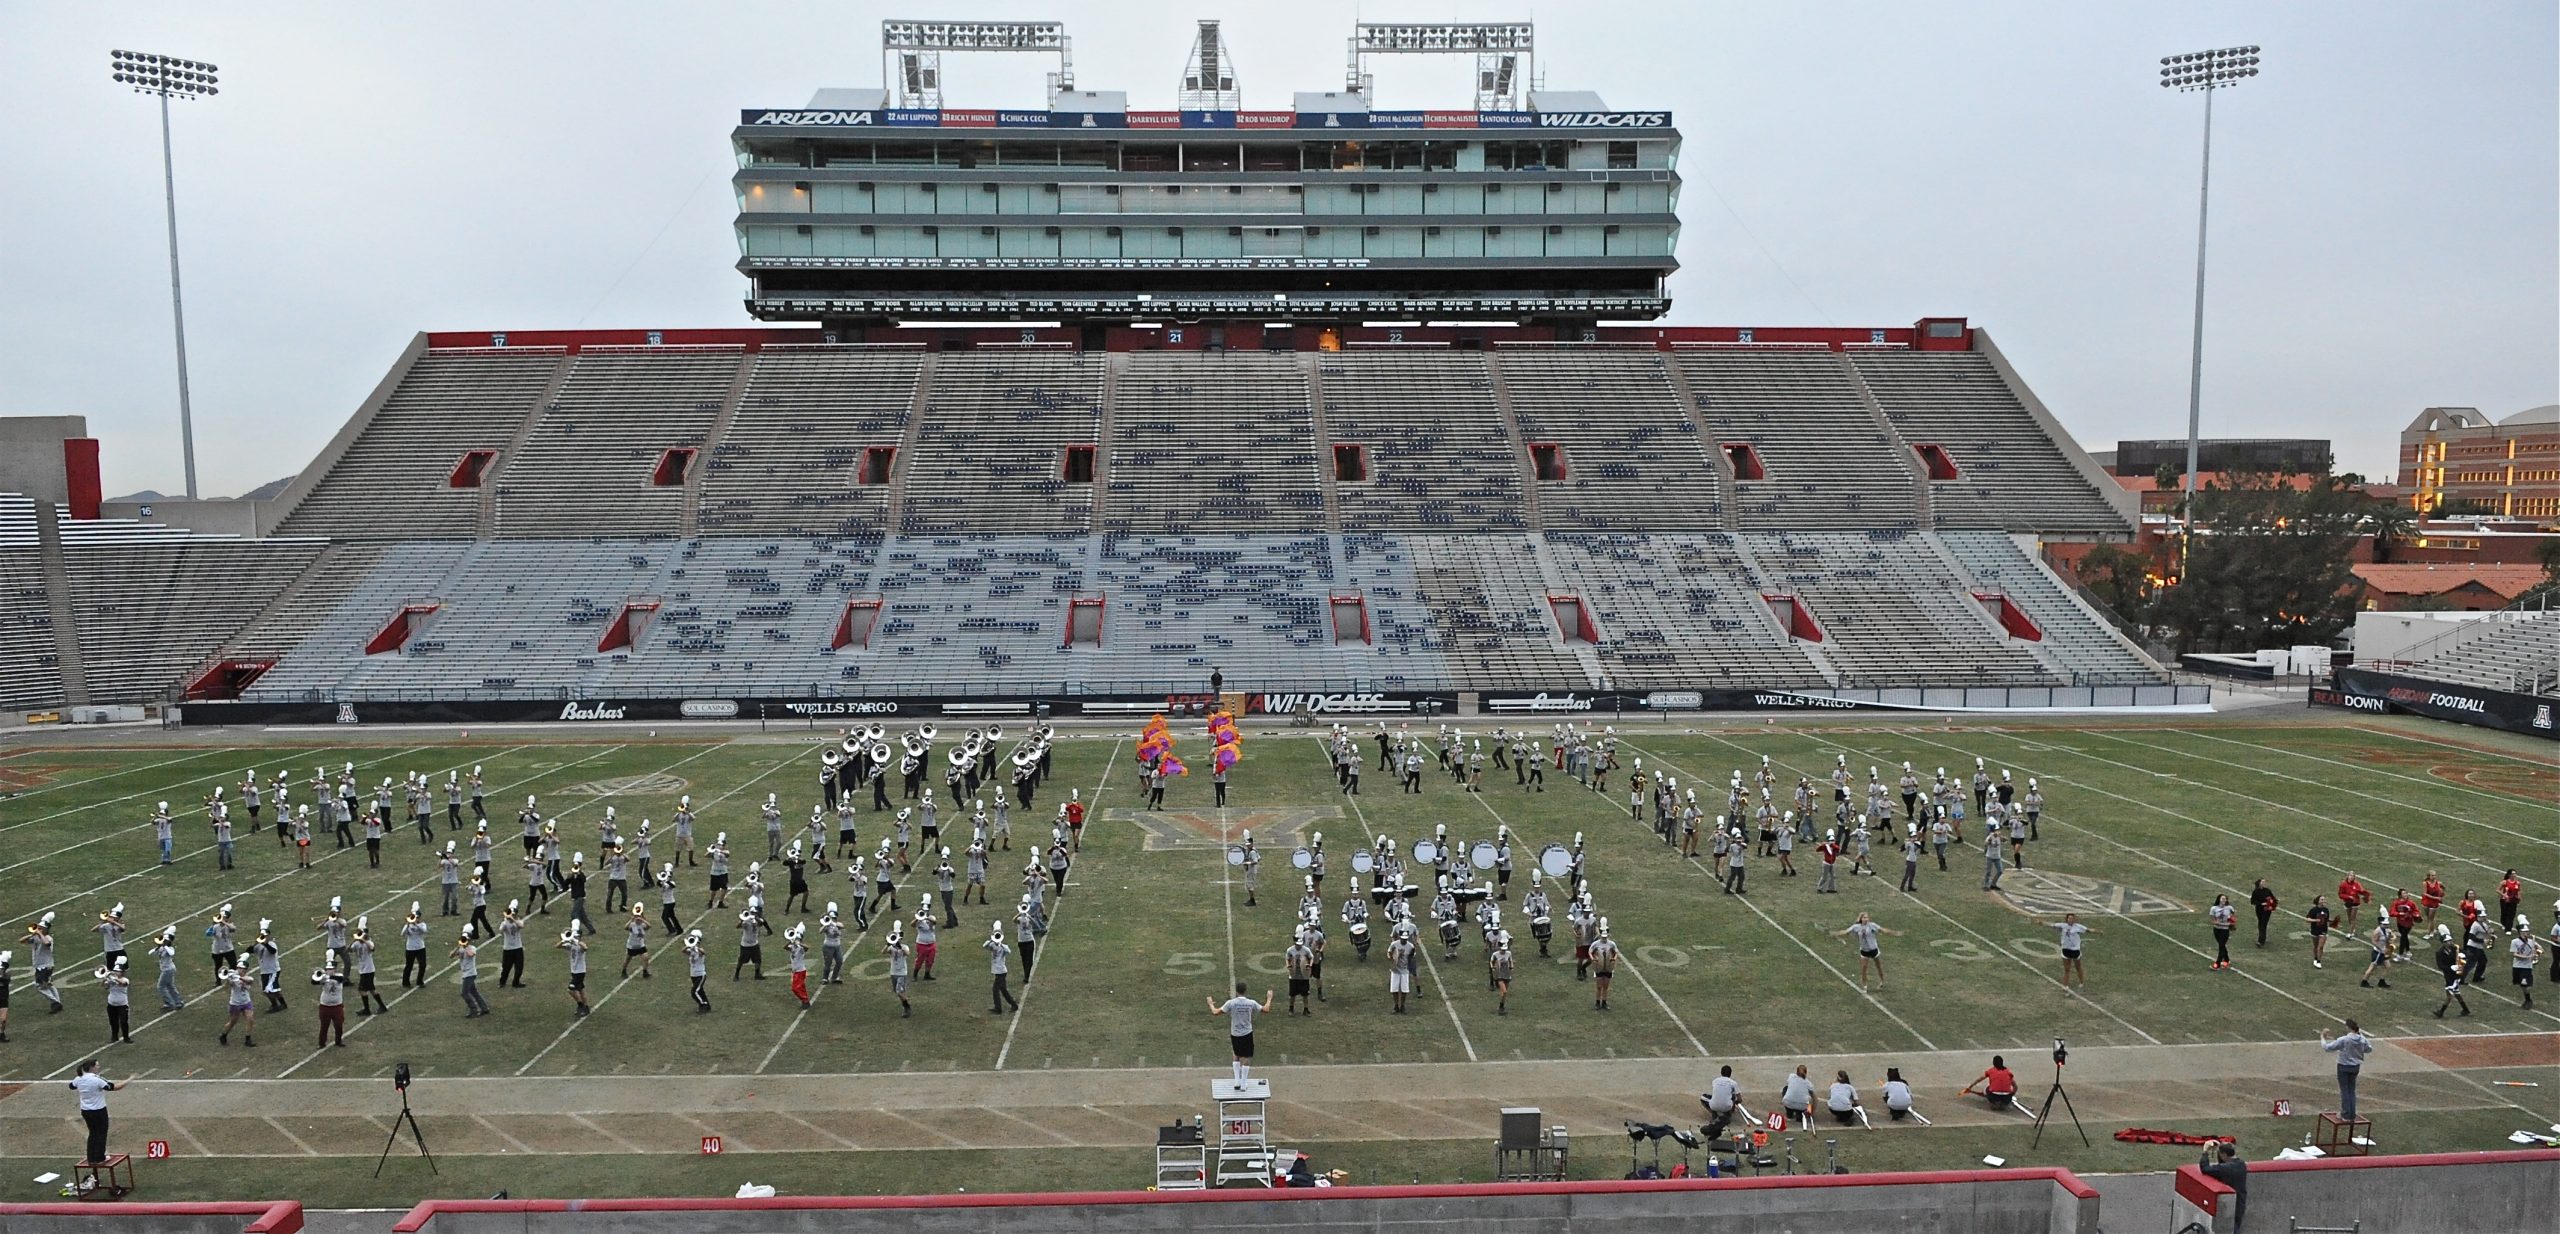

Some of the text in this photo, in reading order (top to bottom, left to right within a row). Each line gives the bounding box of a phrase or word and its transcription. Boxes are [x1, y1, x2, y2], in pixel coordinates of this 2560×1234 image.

[755, 112, 872, 125] ARIZONA
[888, 113, 938, 121] 22 ART LUPPINO
[950, 113, 970, 121] RICKY
[1133, 116, 1159, 124] DARRYLL
[1160, 116, 1180, 124] LEWIS
[1245, 115, 1258, 123] ROB
[1259, 115, 1290, 123] WALDROP
[1377, 115, 1391, 123] STEVE
[1424, 114, 1430, 122] 11
[1485, 115, 1510, 123] ANTOINE
[1511, 115, 1532, 123] CASON
[1540, 114, 1665, 127] WILDCATS
[649, 336, 661, 345] 18
[825, 335, 836, 344] 19
[1022, 334, 1035, 343] 20
[1170, 334, 1181, 342] 21
[1390, 333, 1402, 342] 22
[1583, 333, 1596, 342] 23
[1740, 334, 1752, 343] 24
[1872, 334, 1884, 343] 25
[494, 338, 504, 347] 17
[142, 507, 152, 516] 16
[1755, 695, 1804, 706] WELLS
[2344, 695, 2383, 711] DOWN
[2387, 687, 2485, 713] ARIZONA FOOTBALL
[559, 701, 626, 719] Bashas'
[793, 702, 897, 713] WELLS FARGO
[2276, 1101, 2290, 1116] 30
[1768, 1113, 1783, 1130] 40
[1234, 1120, 1249, 1134] 50
[149, 1142, 166, 1158] 30
[703, 1139, 719, 1153] 40
